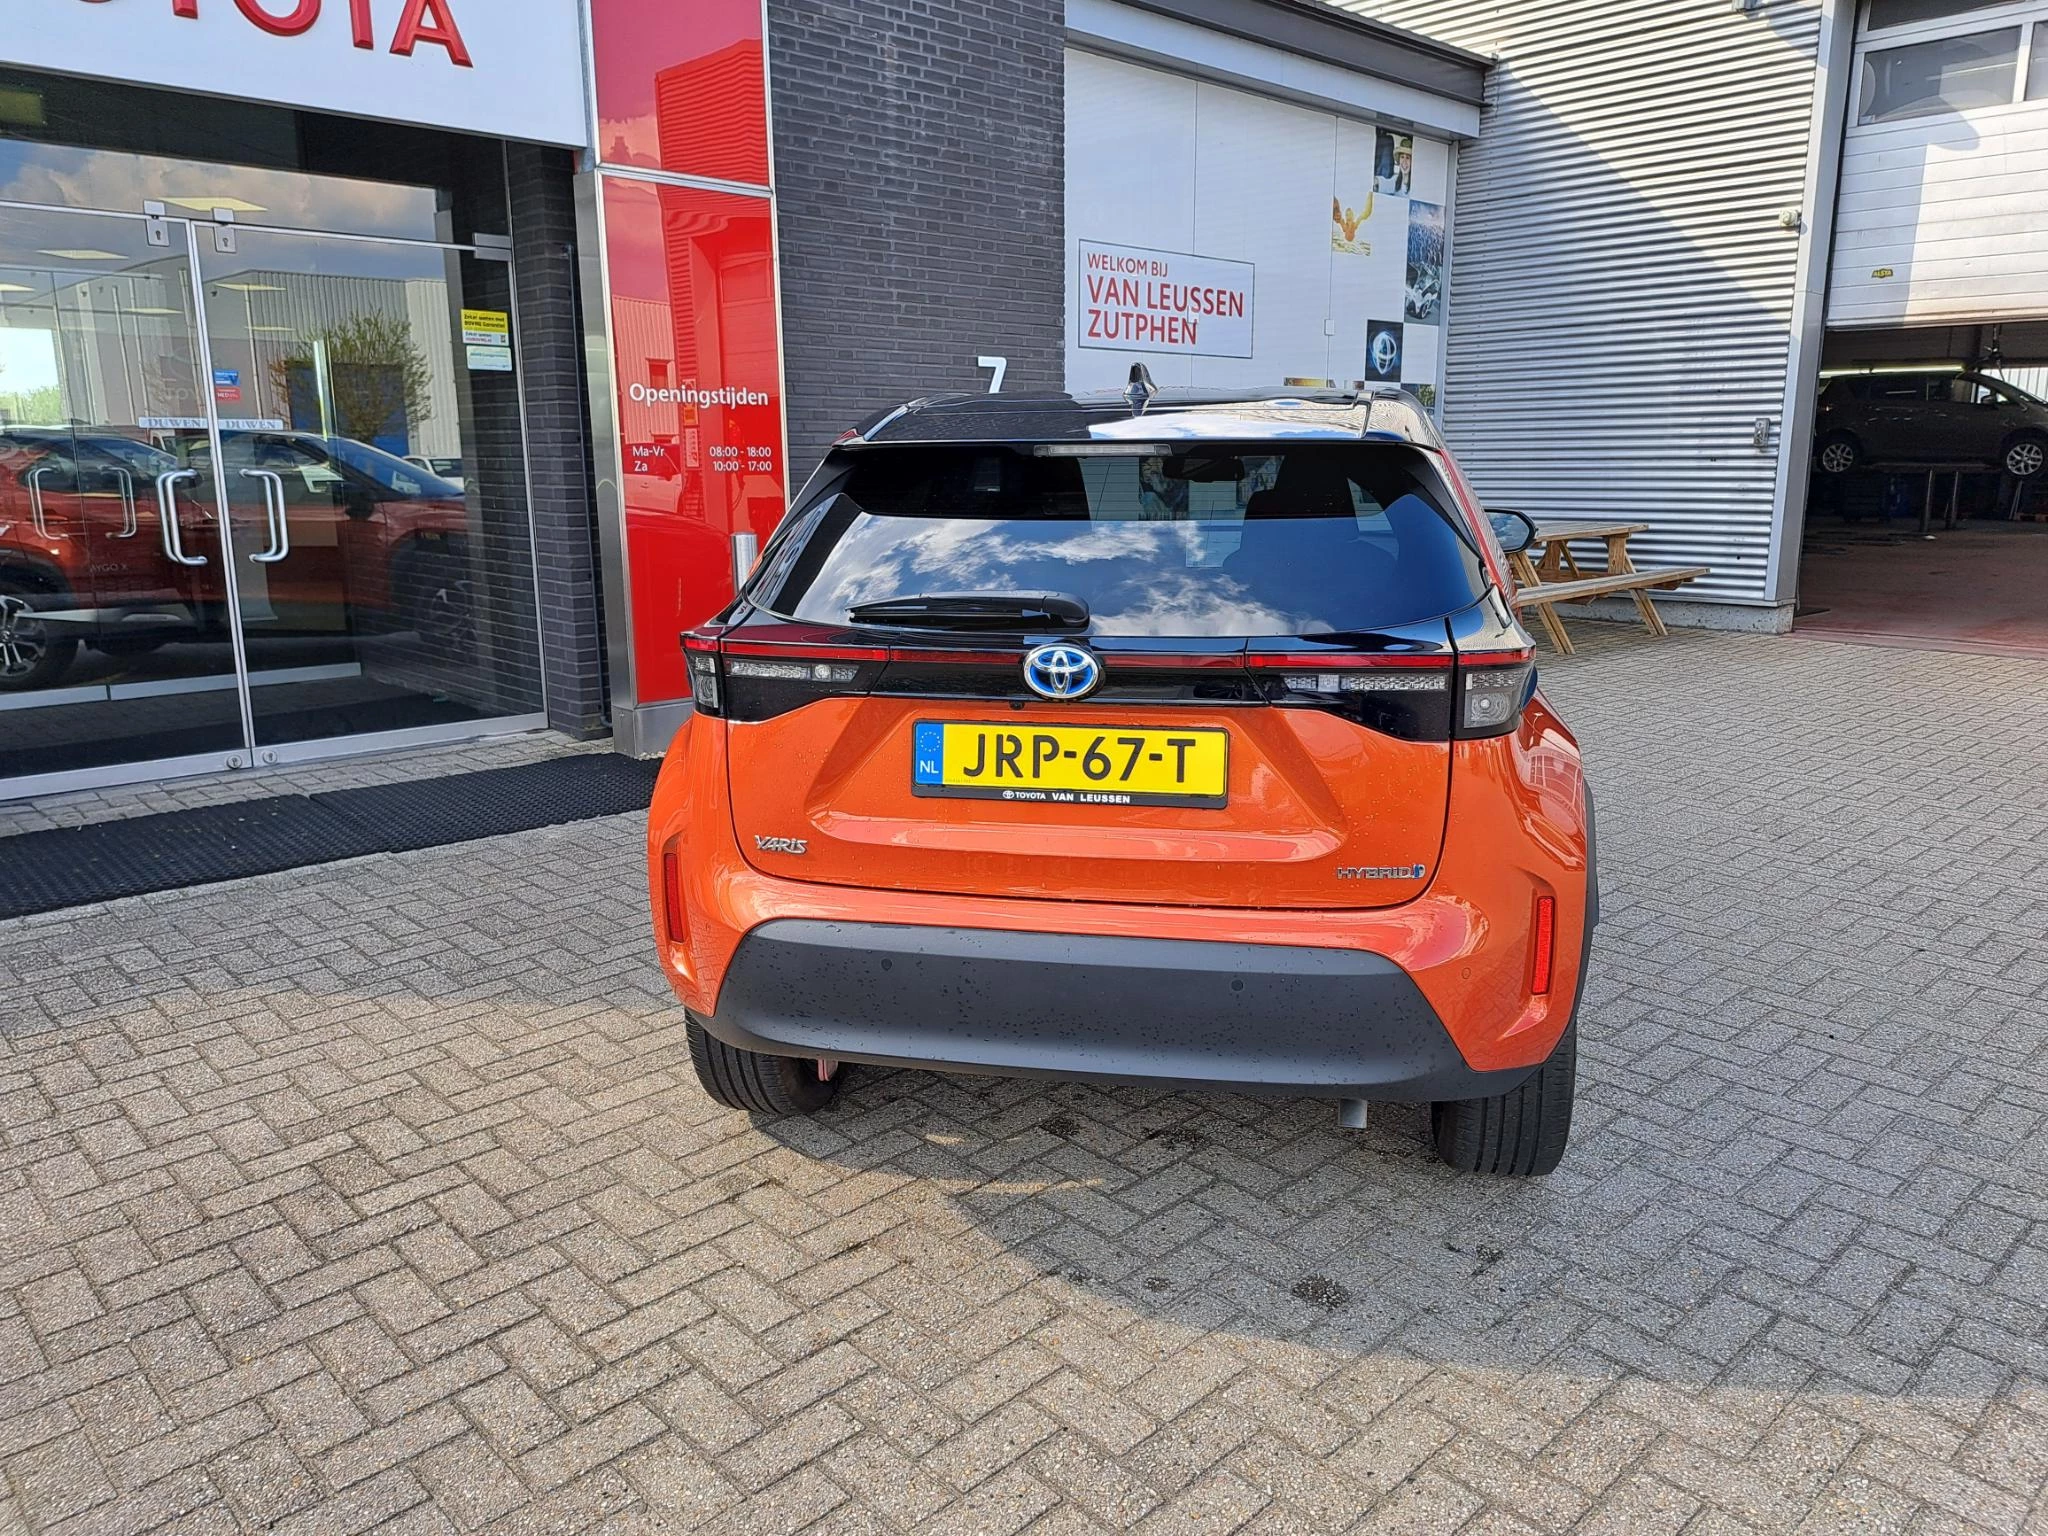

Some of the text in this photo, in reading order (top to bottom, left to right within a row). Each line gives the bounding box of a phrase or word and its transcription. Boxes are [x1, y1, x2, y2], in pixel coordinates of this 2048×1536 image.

[1087, 252, 1168, 278] WELKOM BIJ
[1087, 274, 1244, 318] VAN LEUSSEN
[1088, 309, 1197, 345] ZUTPHEN
[978, 355, 1007, 394] 7
[629, 383, 769, 409] Openingstijden
[149, 419, 201, 428] DUWEN
[226, 420, 276, 429] DUWEN
[632, 446, 665, 457] Ma-Vr
[709, 446, 738, 458] 08:00
[747, 446, 772, 458] 18:00
[634, 460, 648, 472] Za
[713, 460, 739, 472] 10:00
[748, 461, 772, 472] 17:00
[963, 732, 1197, 783] JRP-67-T
[920, 760, 939, 774] NL
[1015, 791, 1130, 804] TOYOTA VAN LEUSSEN
[754, 834, 808, 855] YARIS
[1337, 867, 1411, 879] HYBRID
